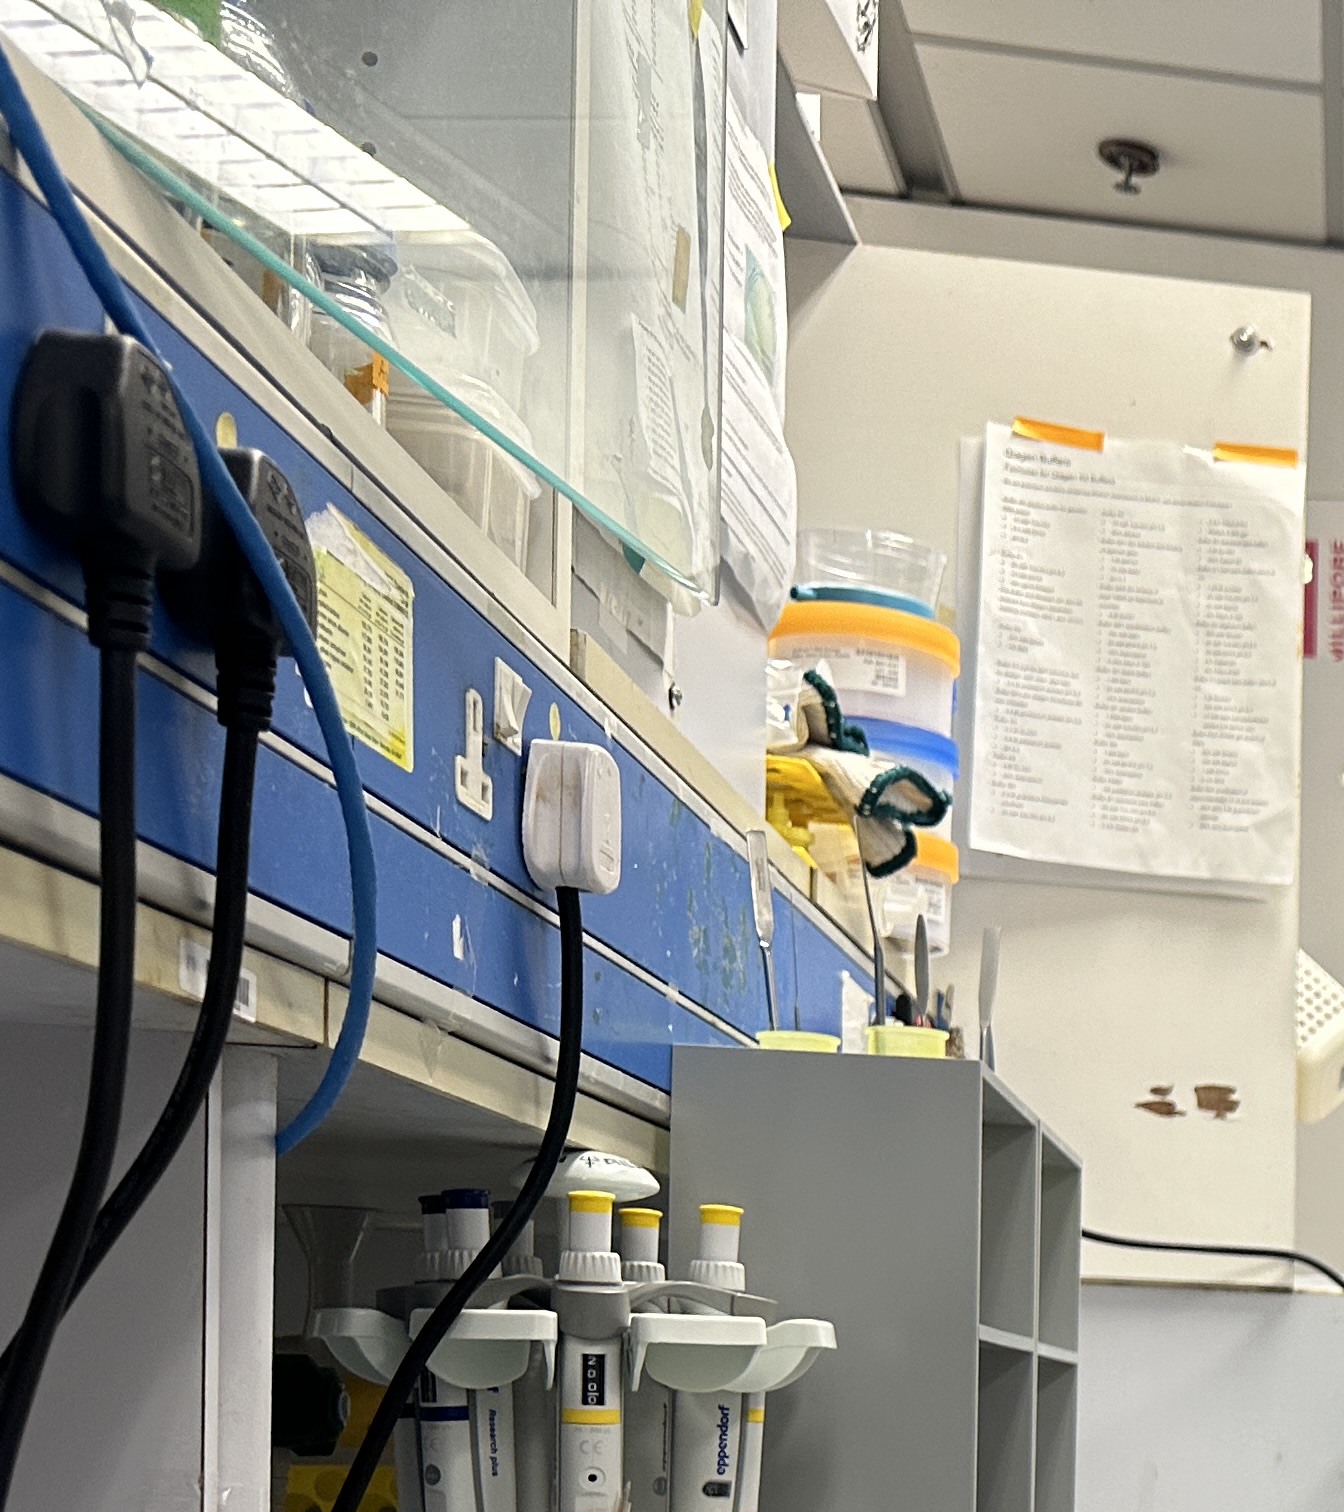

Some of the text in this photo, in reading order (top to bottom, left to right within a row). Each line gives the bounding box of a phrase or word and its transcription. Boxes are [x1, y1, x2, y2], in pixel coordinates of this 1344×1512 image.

[488, 1409, 499, 1477] Research plus
[716, 1404, 731, 1475] eppendorf
